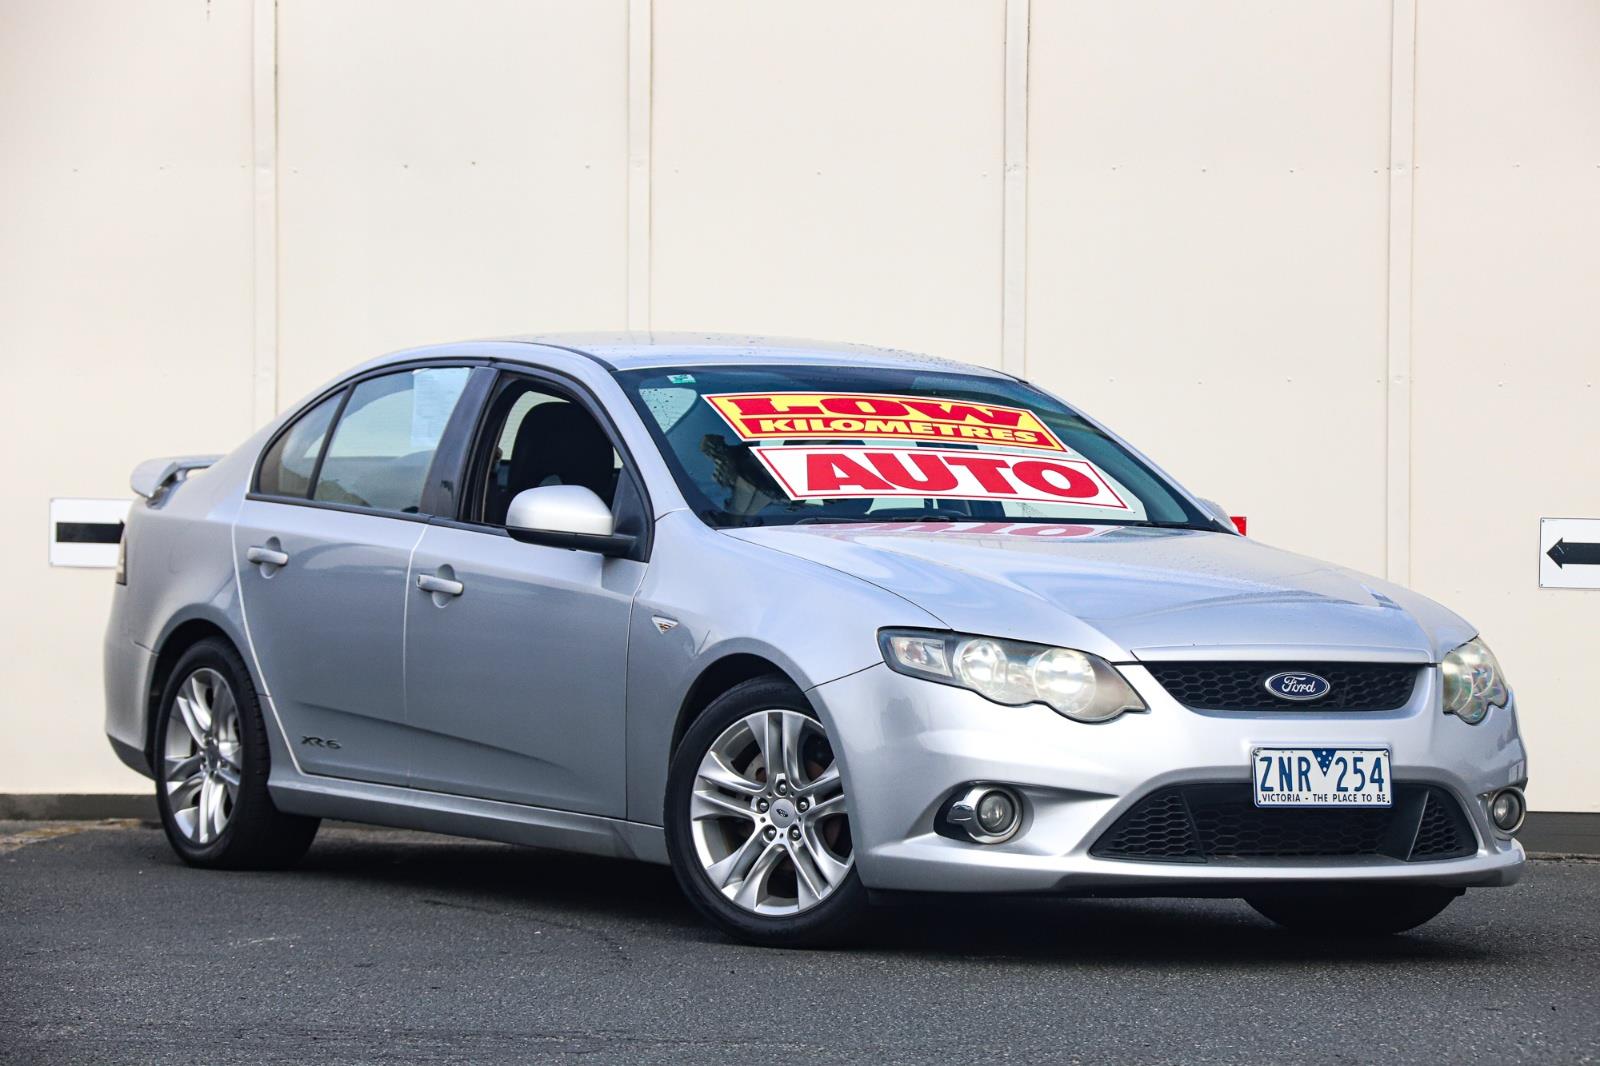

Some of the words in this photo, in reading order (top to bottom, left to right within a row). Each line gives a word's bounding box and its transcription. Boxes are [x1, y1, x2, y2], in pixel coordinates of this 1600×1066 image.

[727, 397, 1022, 427] LOW
[759, 418, 1039, 444] KILOMETRES
[806, 453, 1100, 499] AUTO
[1281, 676, 1316, 693] Ford
[302, 735, 342, 749] XR6
[1259, 756, 1312, 792] ZNR
[1335, 756, 1385, 792] 254
[1262, 793, 1301, 803] VICTORIA
[1313, 793, 1328, 803] THE
[1332, 793, 1358, 803] PLACE
[1361, 793, 1373, 803] TO
[1376, 793, 1386, 803] BE
